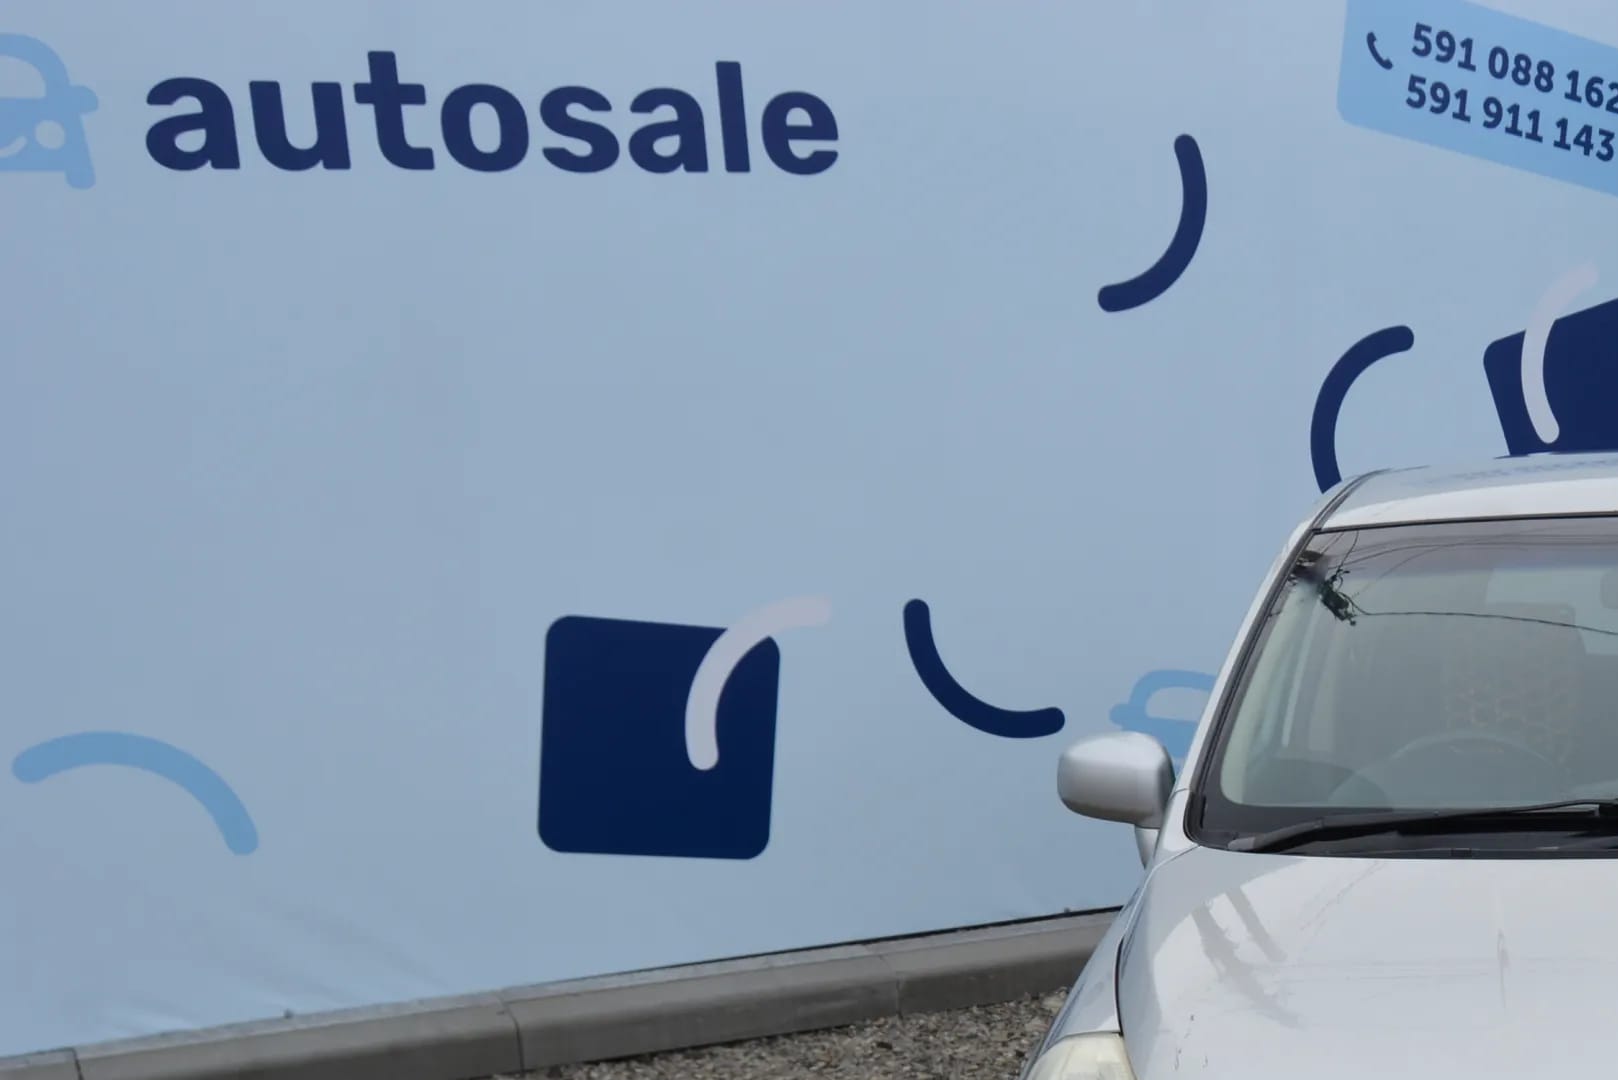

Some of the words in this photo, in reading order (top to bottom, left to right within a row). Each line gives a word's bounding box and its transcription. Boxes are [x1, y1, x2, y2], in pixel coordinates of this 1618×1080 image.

[1412, 22, 1477, 72] 591
[1488, 46, 1555, 93] 088
[145, 50, 840, 176] autosale
[1406, 74, 1471, 123] 591
[1482, 96, 1543, 143] 911
[1553, 117, 1616, 162] 143
